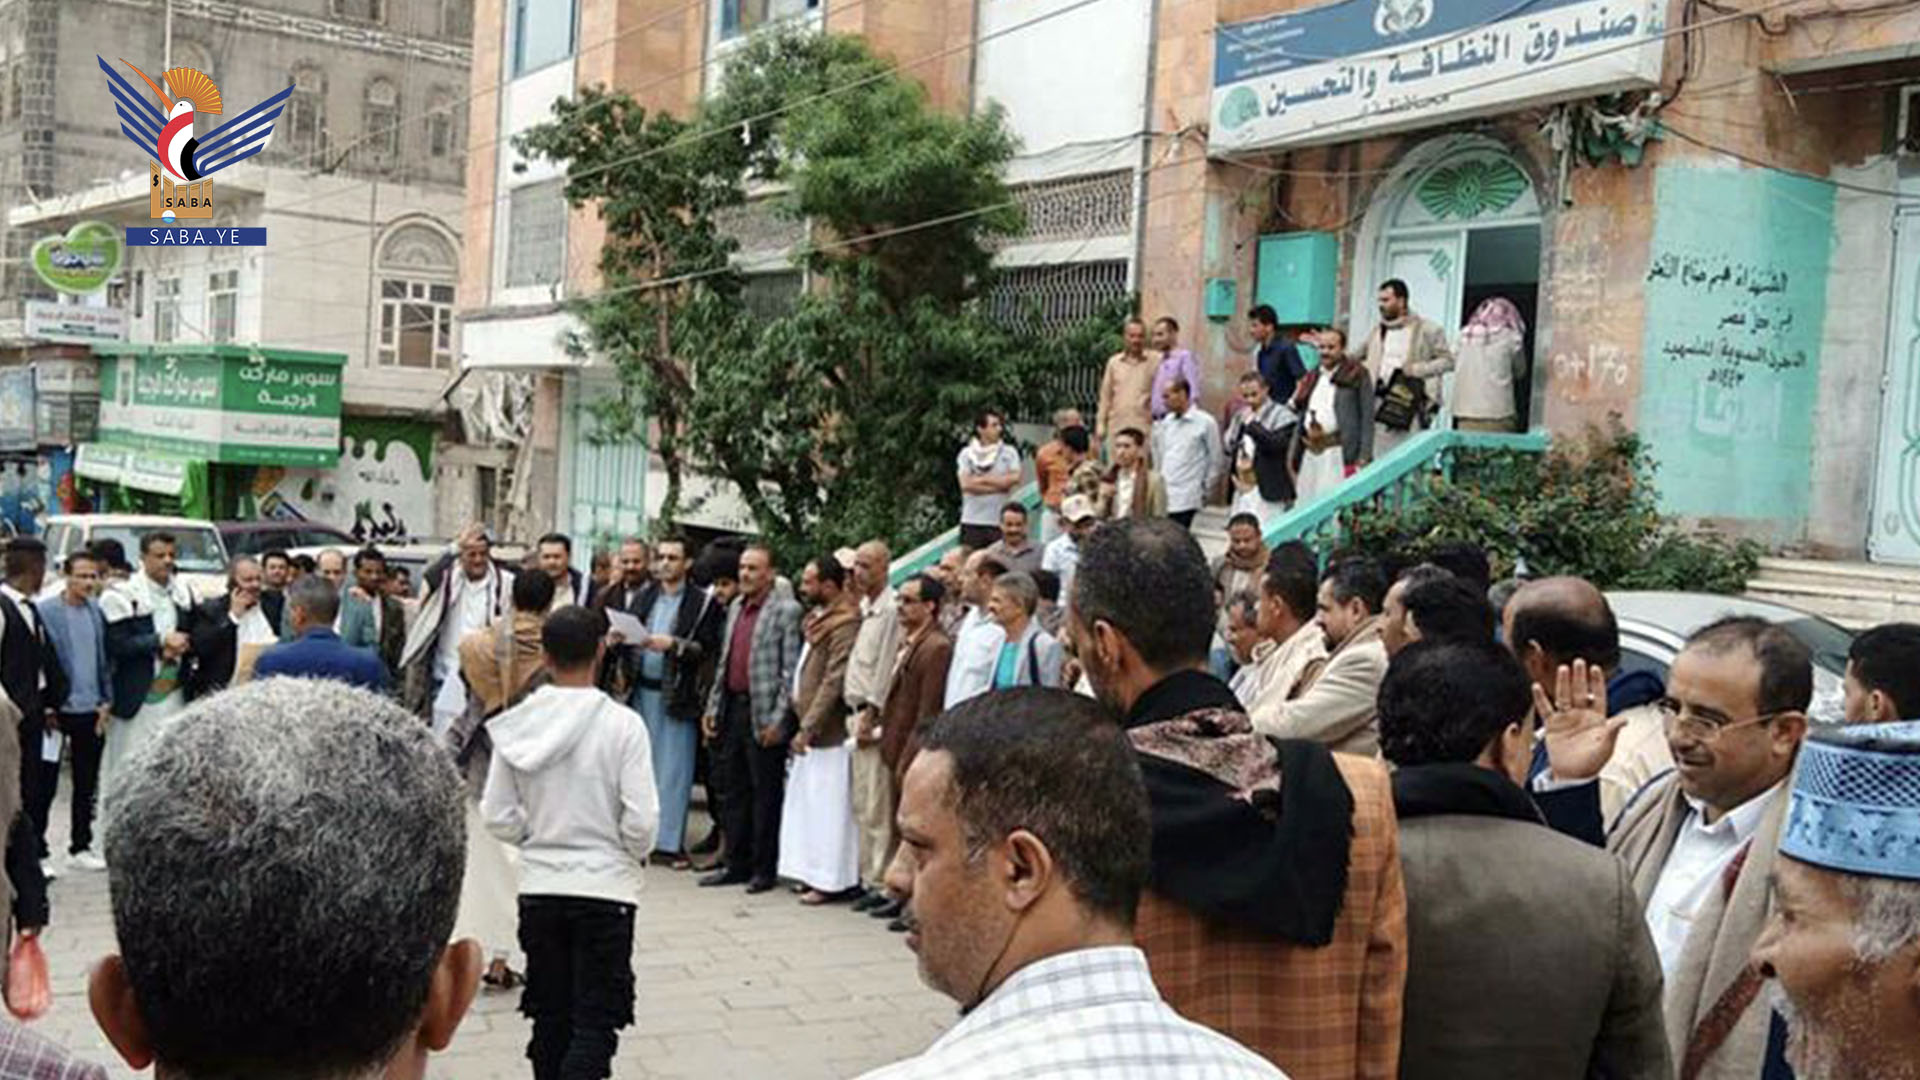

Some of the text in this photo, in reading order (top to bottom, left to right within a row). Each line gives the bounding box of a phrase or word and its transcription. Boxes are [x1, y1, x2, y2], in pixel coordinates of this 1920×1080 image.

[1388, 33, 1511, 84] النظافة
[1523, 7, 1638, 65] صندوق
[1266, 64, 1378, 117] والتحسين
